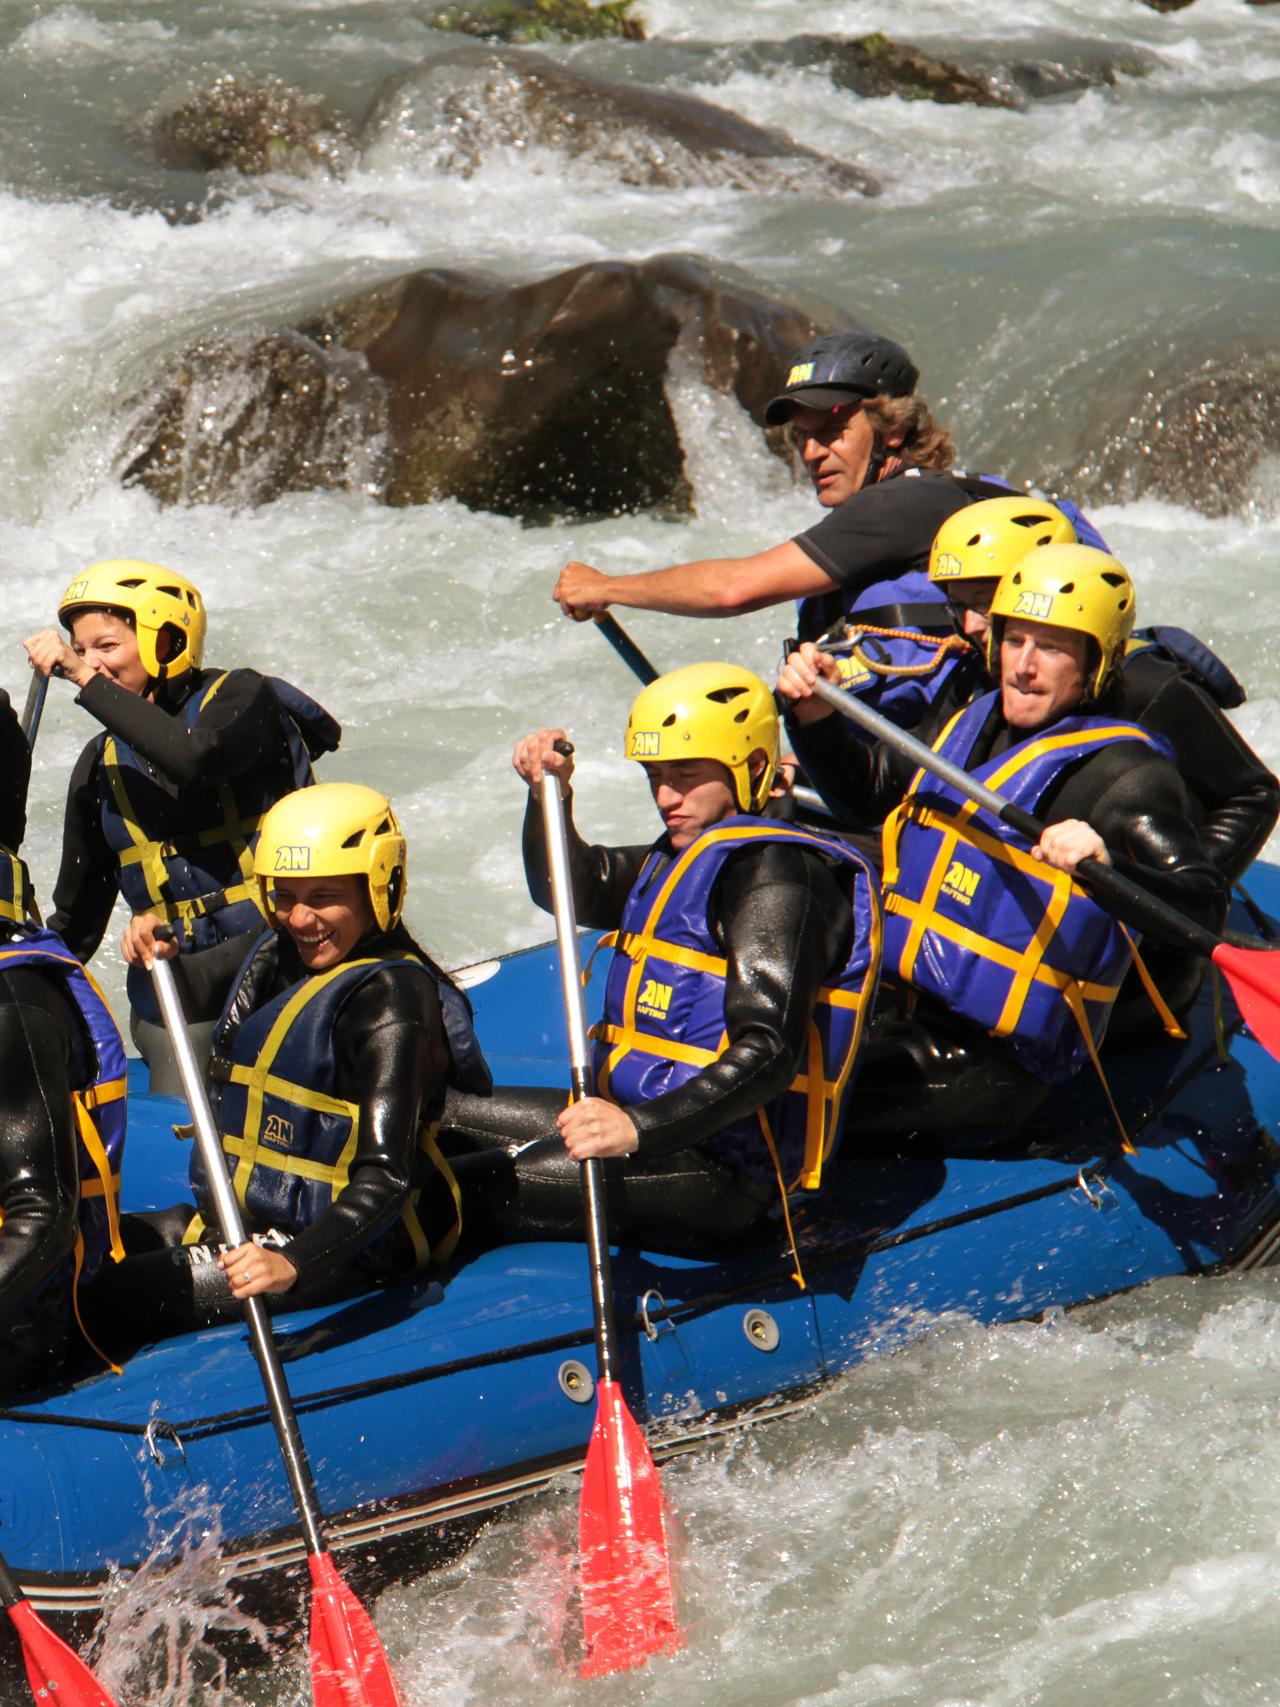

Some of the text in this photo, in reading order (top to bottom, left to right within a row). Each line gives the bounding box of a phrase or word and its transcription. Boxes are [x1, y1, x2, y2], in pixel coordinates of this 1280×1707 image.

[935, 554, 961, 577] AN
[1013, 591, 1053, 618] AN
[631, 732, 660, 756] AN
[275, 846, 310, 870] AN
[943, 861, 981, 897] AN
[638, 980, 672, 1010] AN
[264, 1115, 294, 1144] AN
